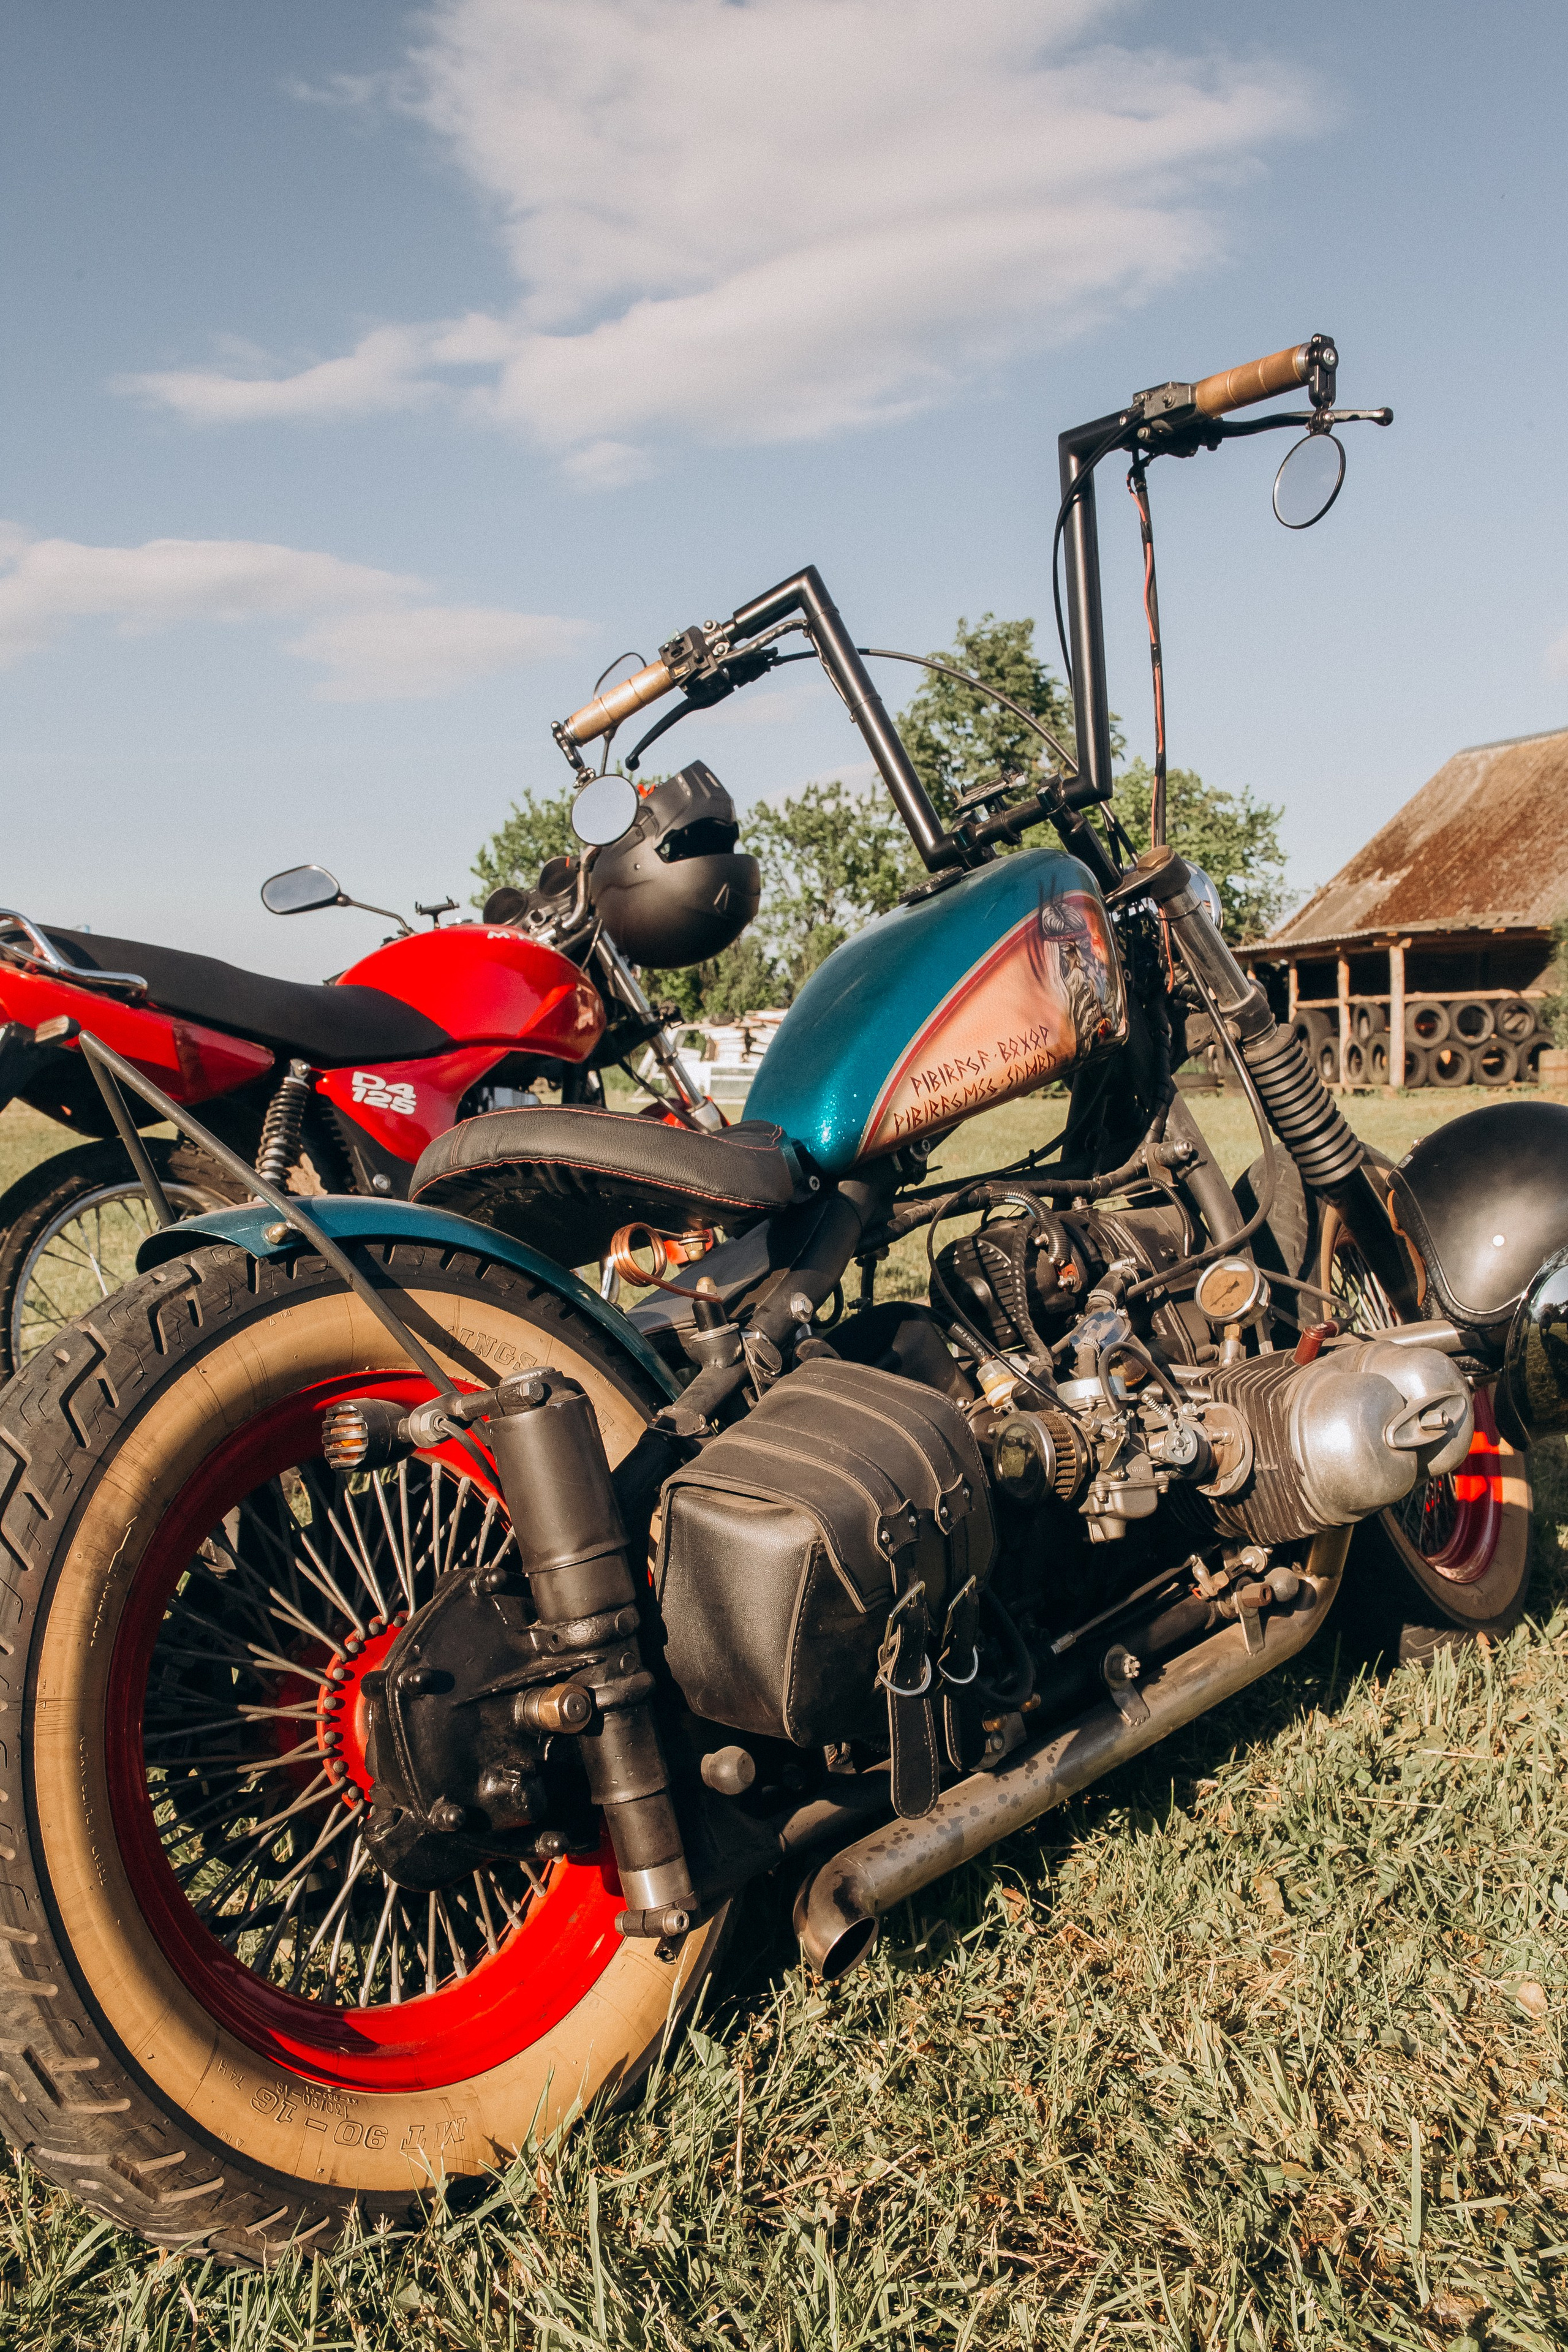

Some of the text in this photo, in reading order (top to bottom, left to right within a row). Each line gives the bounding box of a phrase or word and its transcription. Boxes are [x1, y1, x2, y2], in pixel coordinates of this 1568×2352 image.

[352, 1071, 417, 1099] D4
[352, 1087, 417, 1115] 125
[966, 1335, 979, 1348] 3225
[276, 2081, 348, 2119] 130/90-16
[250, 2087, 467, 2150] MT 90-16
